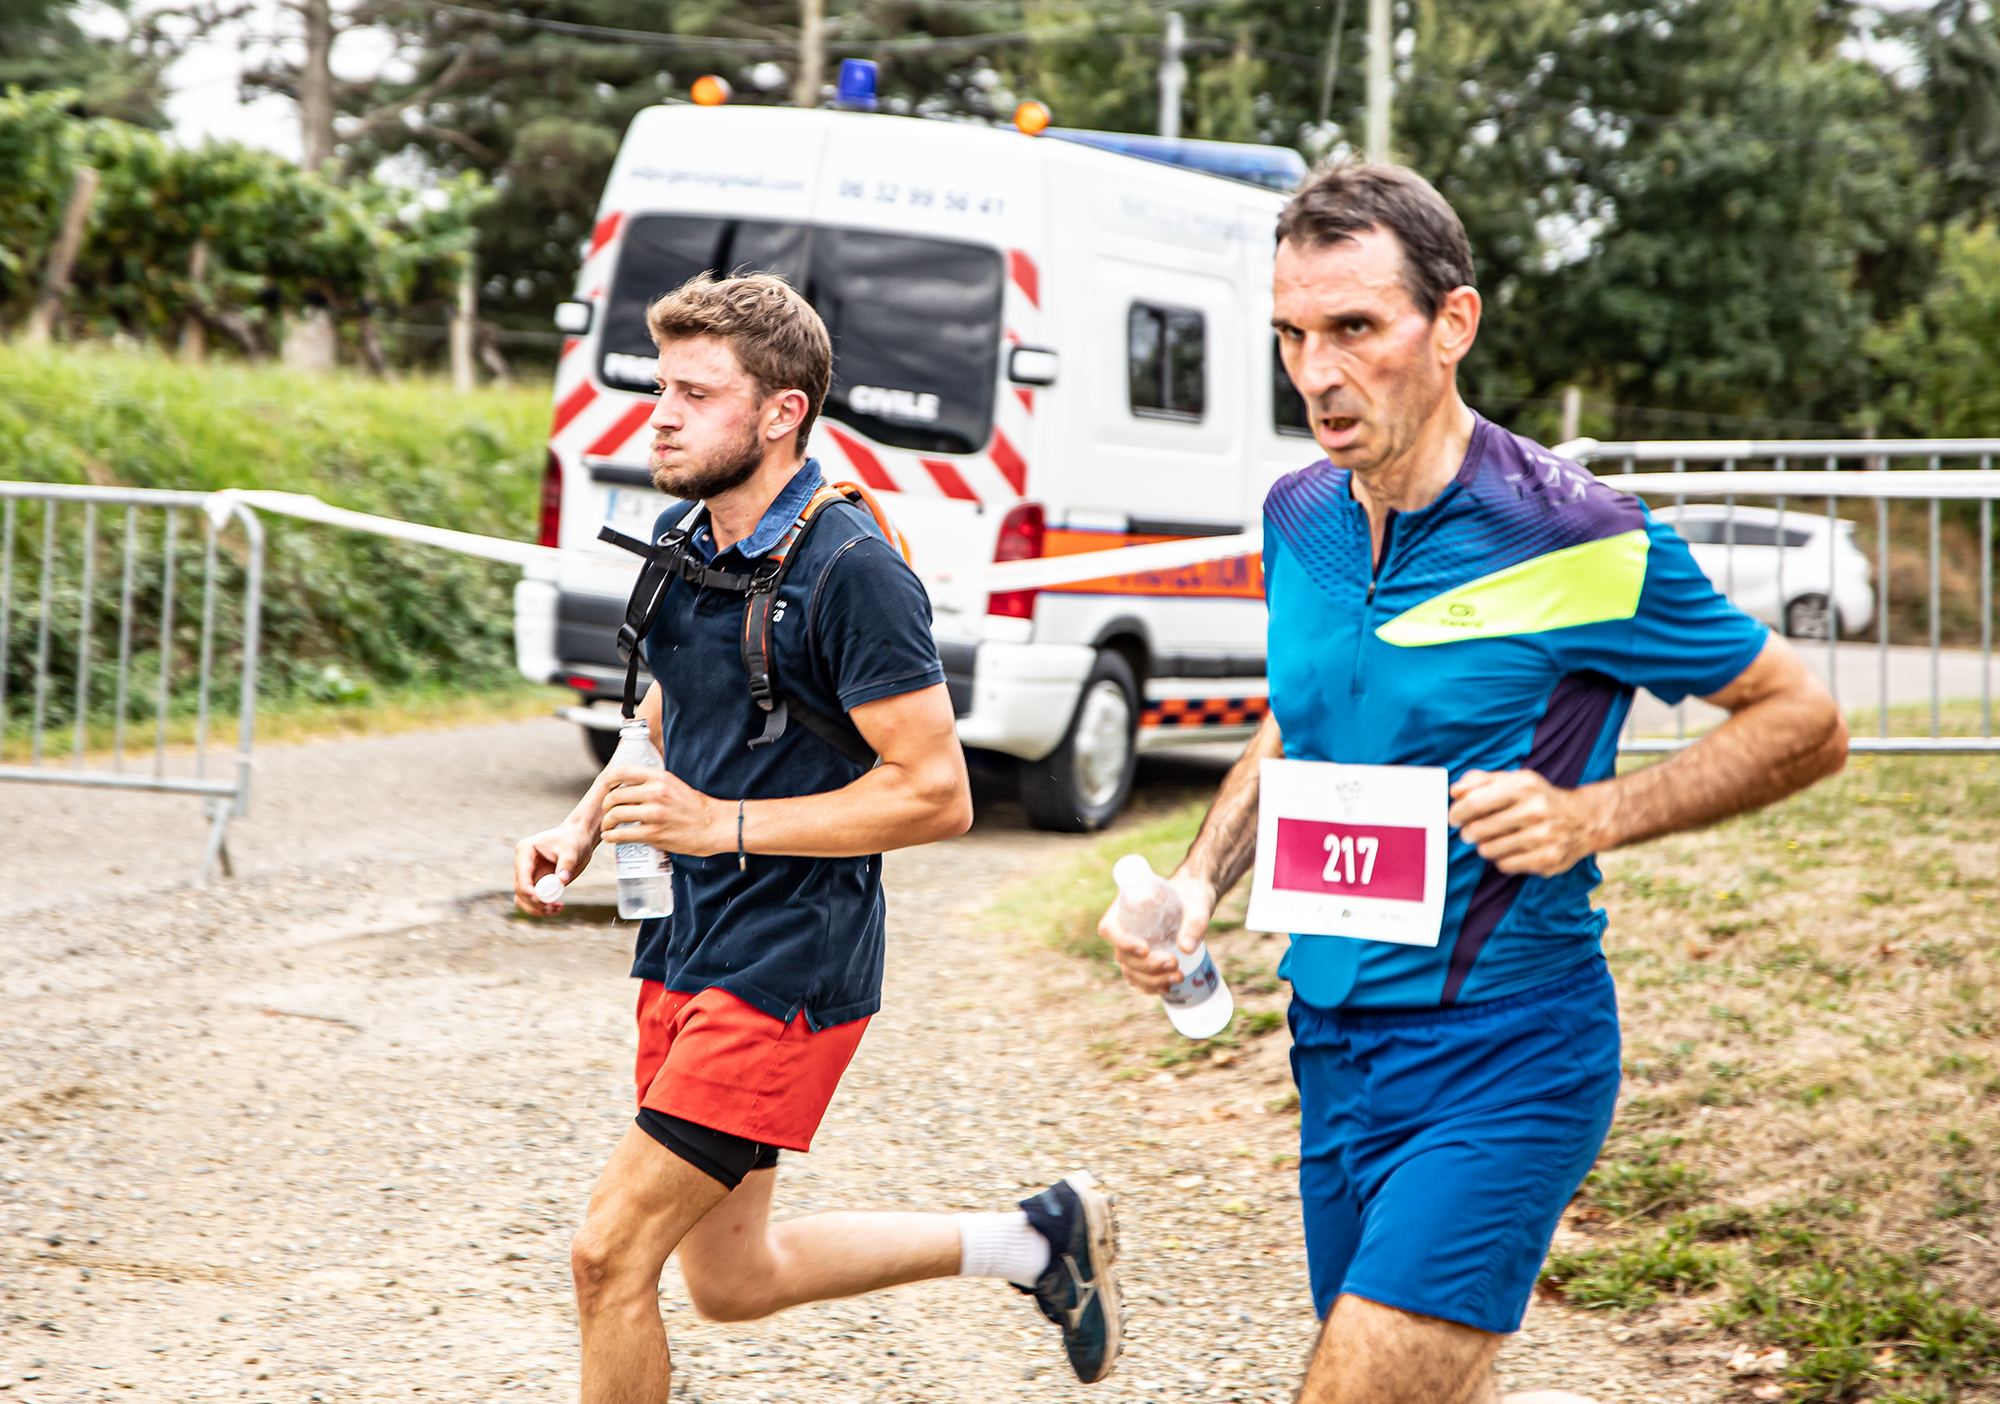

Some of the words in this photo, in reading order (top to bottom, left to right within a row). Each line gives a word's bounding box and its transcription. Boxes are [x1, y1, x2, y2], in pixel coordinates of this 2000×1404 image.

[839, 177, 863, 198] 06
[874, 181, 900, 203] 32
[848, 384, 940, 421] CIVILE
[1322, 833, 1379, 885] 217
